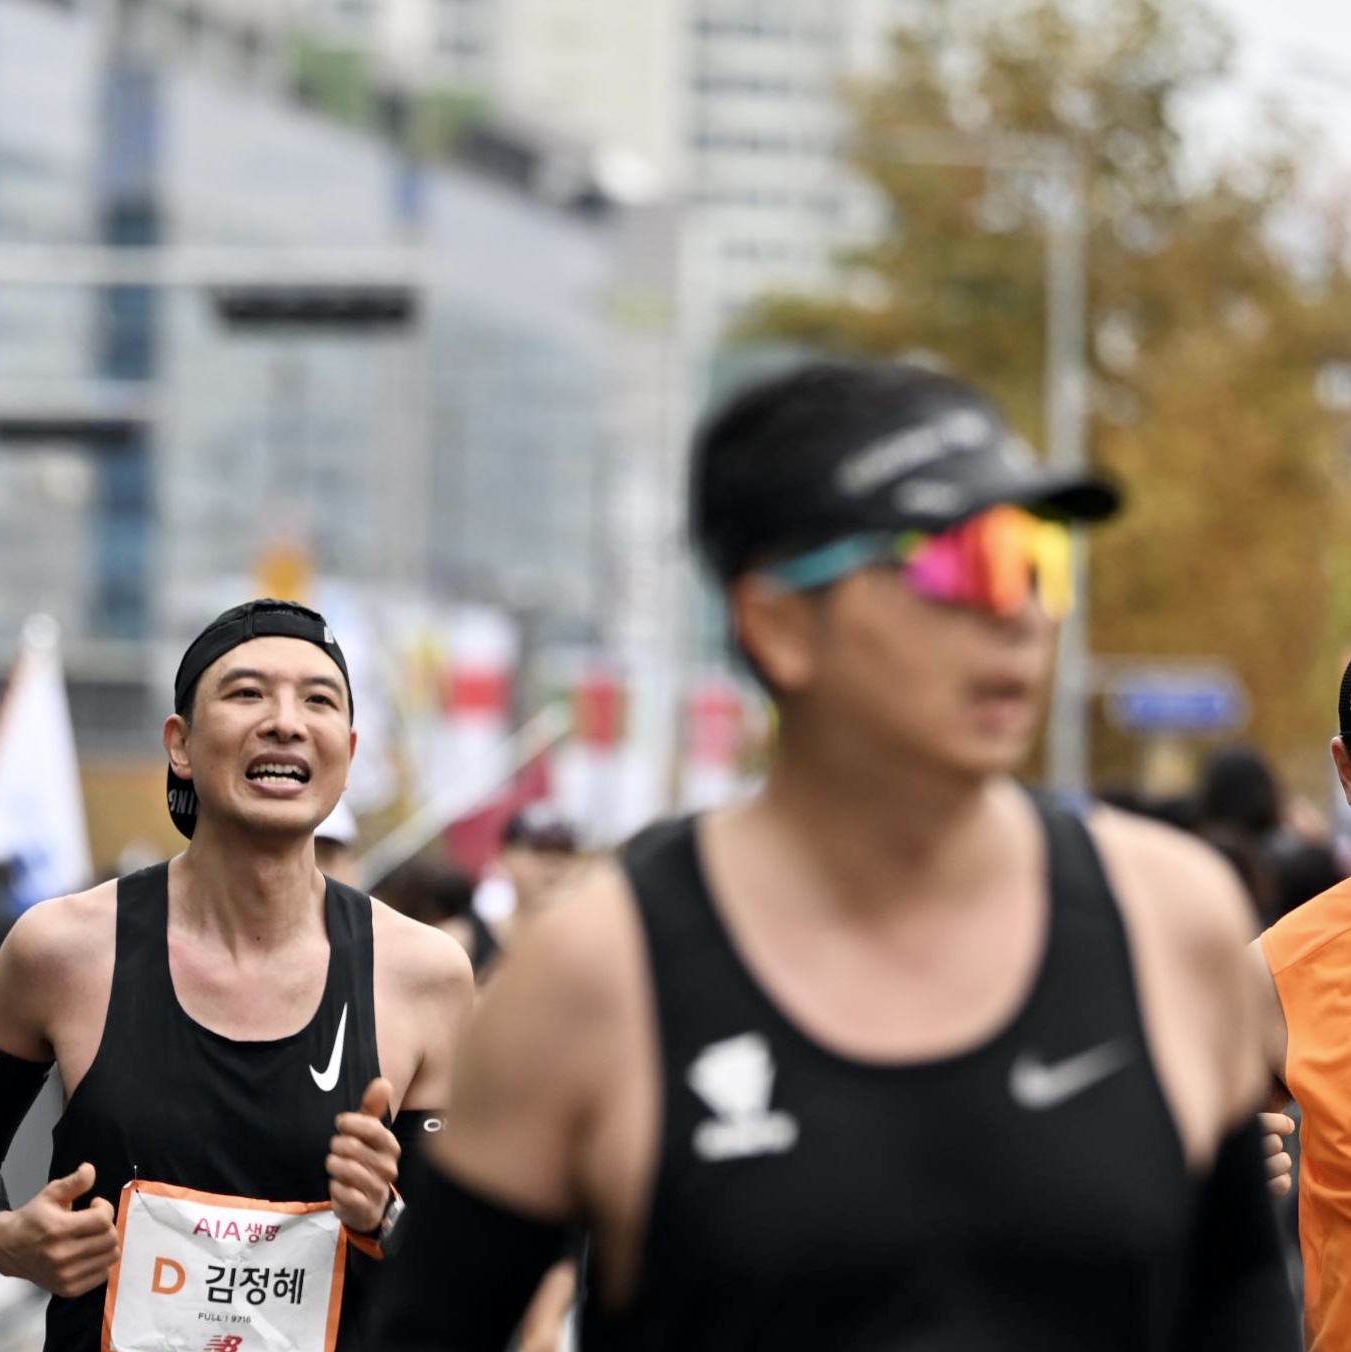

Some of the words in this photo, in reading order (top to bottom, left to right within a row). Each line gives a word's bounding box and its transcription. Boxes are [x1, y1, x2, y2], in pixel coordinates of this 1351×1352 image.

[151, 1257, 186, 1295] D
[205, 1265, 305, 1306] 김정혜
[198, 1312, 222, 1322] FULL
